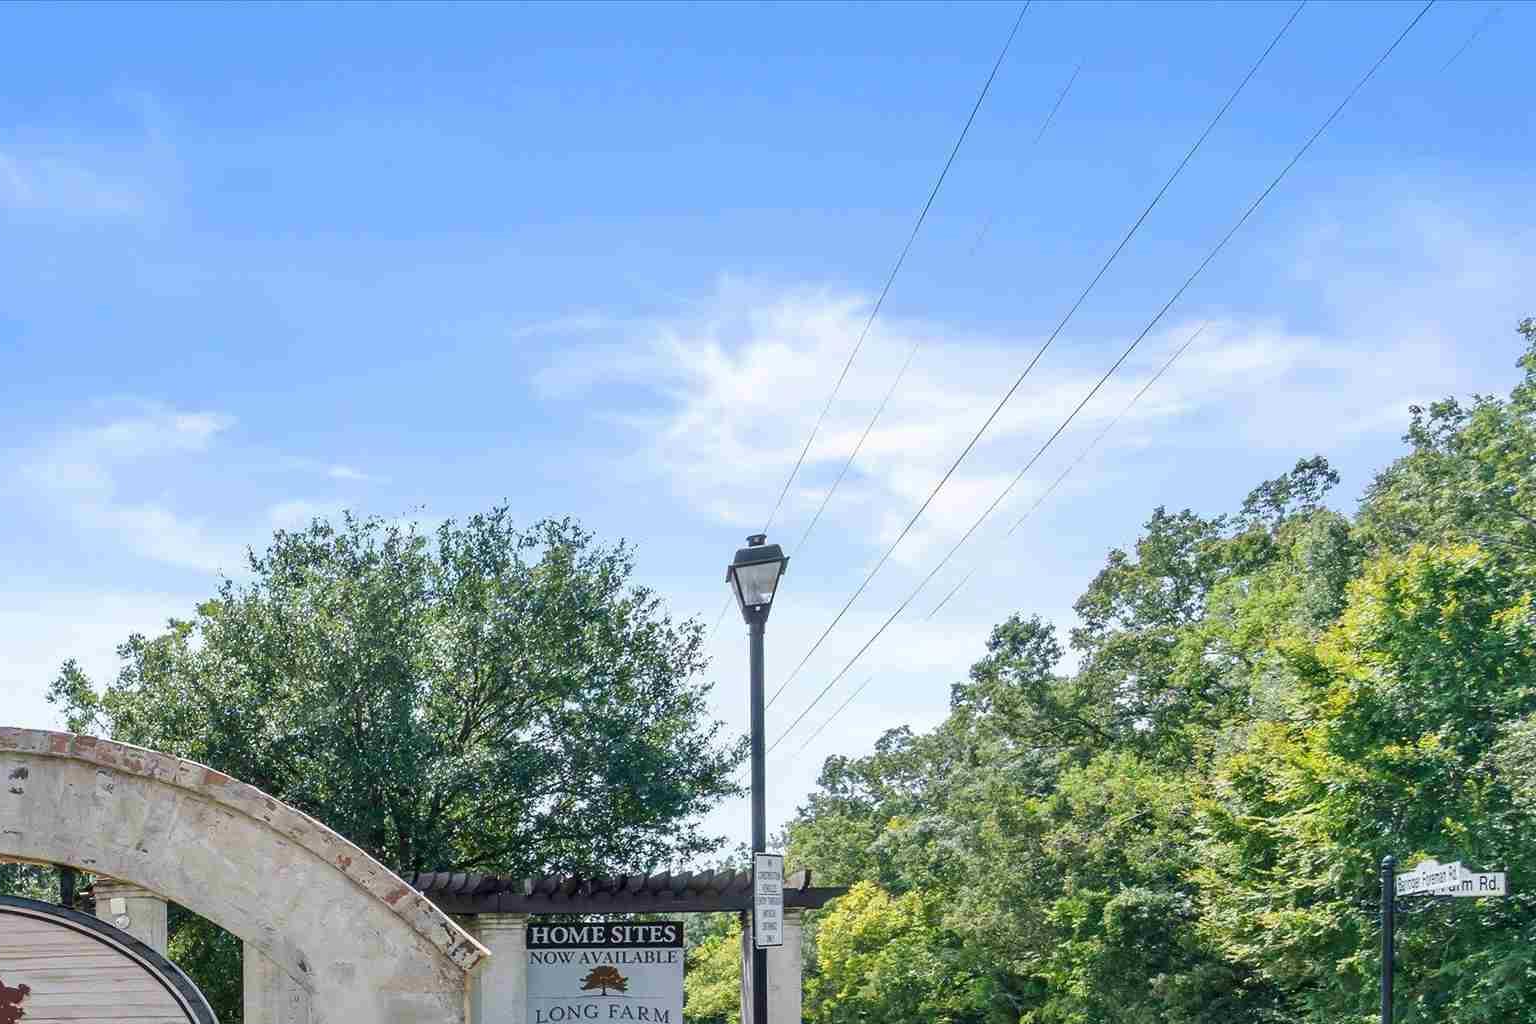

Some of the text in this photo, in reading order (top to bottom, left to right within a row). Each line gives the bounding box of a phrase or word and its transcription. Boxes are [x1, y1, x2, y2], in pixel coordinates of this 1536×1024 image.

[1479, 875, 1500, 891] Rd.
[531, 925, 676, 944] HOME SITES
[530, 951, 678, 965] NOW AVAILABLE
[535, 1004, 671, 1024] LONG FARM
